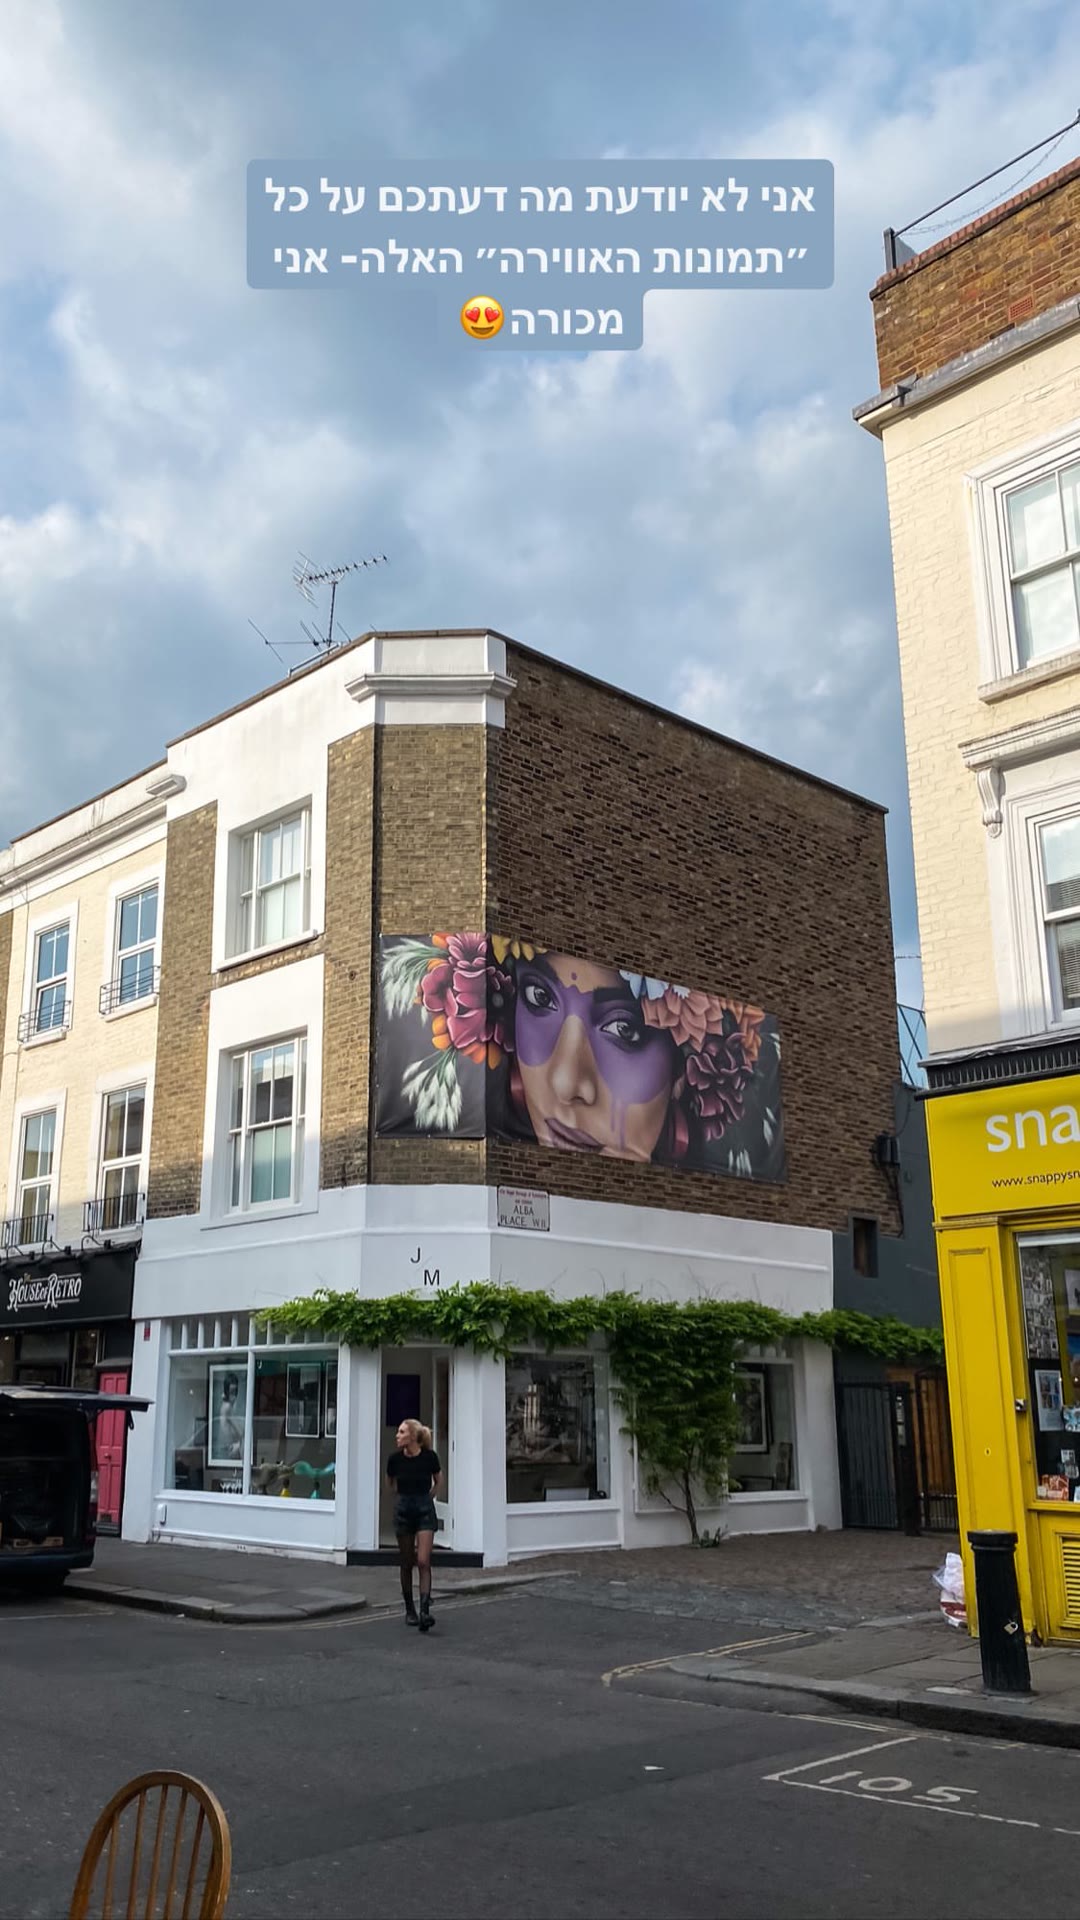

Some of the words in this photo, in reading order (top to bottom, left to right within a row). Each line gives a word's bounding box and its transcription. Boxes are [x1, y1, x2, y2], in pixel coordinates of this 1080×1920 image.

[986, 1104, 1080, 1153] sna
[513, 1205, 535, 1216] ALBA
[410, 1247, 421, 1264] J
[424, 1269, 440, 1286] M
